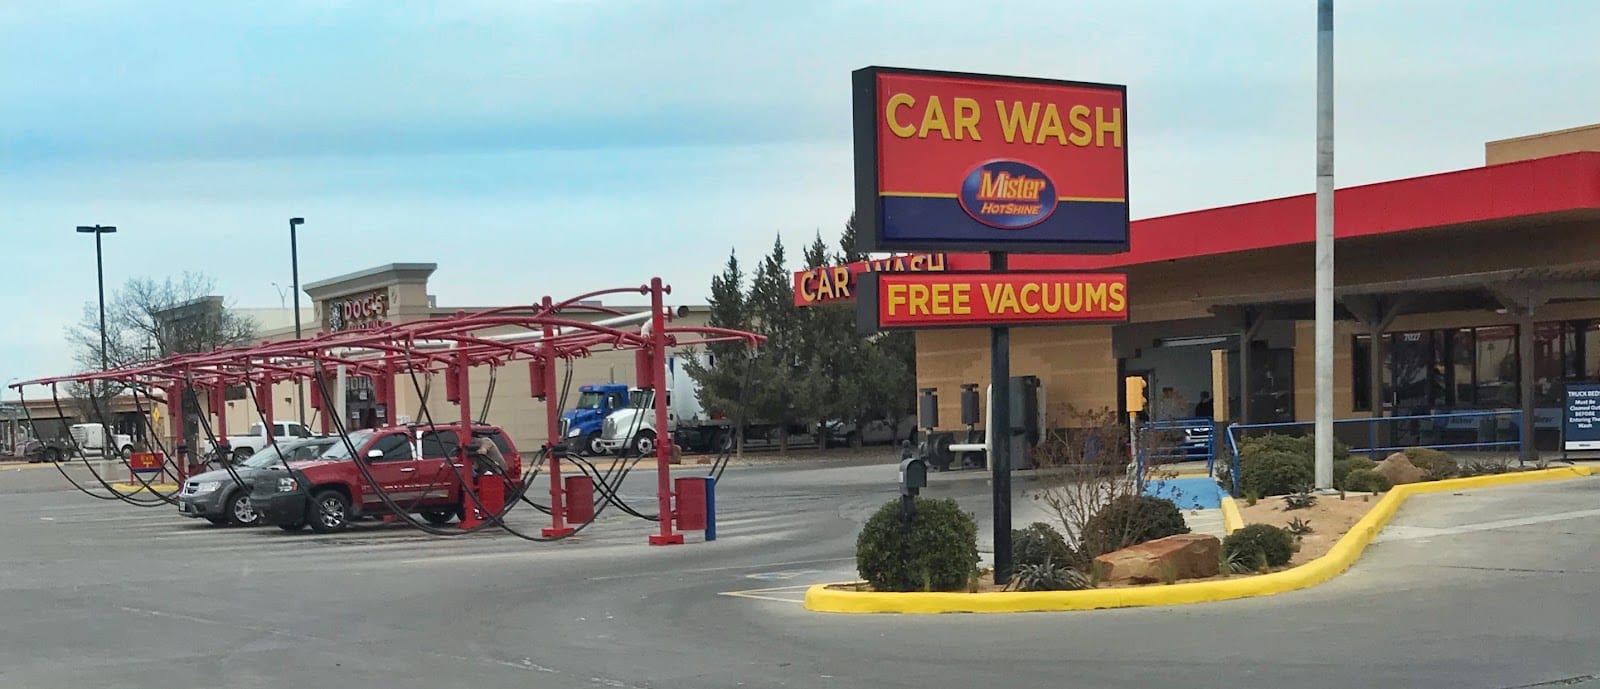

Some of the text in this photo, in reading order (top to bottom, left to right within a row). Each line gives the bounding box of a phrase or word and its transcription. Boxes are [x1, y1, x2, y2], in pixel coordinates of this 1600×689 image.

[885, 93, 1122, 148] CAR WASH
[977, 170, 1046, 200] Mister
[800, 267, 851, 302] CAR
[886, 281, 1126, 316] FREE VACUUMS
